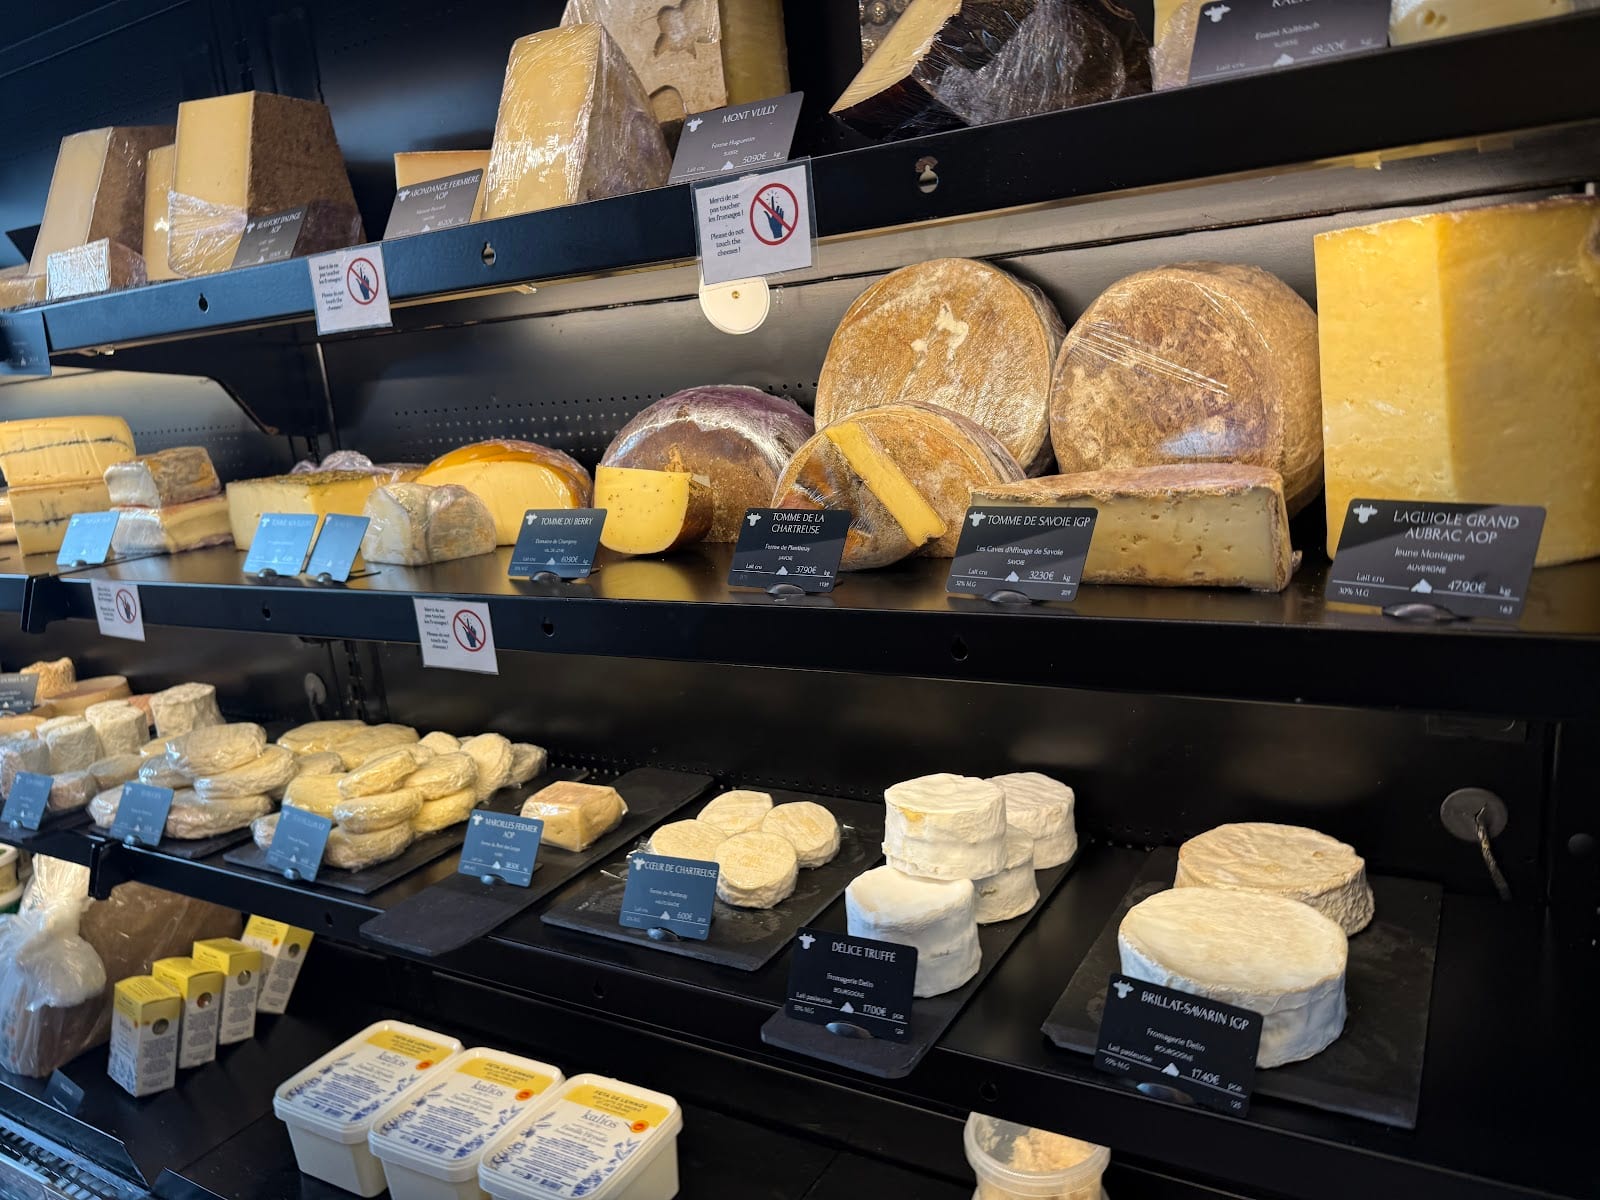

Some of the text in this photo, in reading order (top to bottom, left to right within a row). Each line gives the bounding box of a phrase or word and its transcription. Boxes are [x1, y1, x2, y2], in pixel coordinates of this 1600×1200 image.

[1256, 21, 1320, 40] Emmi Kaltbach
[722, 104, 778, 124] MONT VULLY
[434, 191, 449, 201] AOP
[710, 195, 725, 205] Merci
[710, 203, 740, 215] pas toucher
[716, 212, 741, 221] fromages
[711, 233, 728, 241] Please
[716, 240, 731, 248] touch
[718, 249, 738, 257] cheeses
[541, 518, 594, 526] TOMME DU BERRY
[772, 512, 825, 523] TOMME DE LA
[988, 515, 1091, 528] TOMME DE SAVOIE IGP
[1393, 510, 1520, 530] LAGUIOLE GRAND
[771, 524, 821, 534] CHARTREUSE
[1404, 526, 1498, 545] AUBRAC AOP
[1034, 547, 1042, 555] de
[1043, 548, 1064, 556] Savoie
[1394, 547, 1466, 563] Jeune Montagne
[1406, 563, 1447, 575] AUVERGNE
[1062, 574, 1071, 583] kg
[1356, 573, 1385, 584] Lait cru
[1499, 586, 1512, 598] kg
[515, 823, 538, 833] FERMIER
[503, 831, 516, 839] AOP
[644, 861, 717, 879] CŒUR DE CHARTREUSE
[831, 941, 897, 963] DÉLICE TRUFFÉ
[826, 972, 858, 985] Fromagerie
[1141, 990, 1250, 1031] BRILLAT-SAVARIN IGP
[1146, 1027, 1206, 1053] Fromagerie Delin
[1107, 1042, 1121, 1051] Lait
[471, 1080, 506, 1097] kalios
[581, 1109, 620, 1129] kalios
